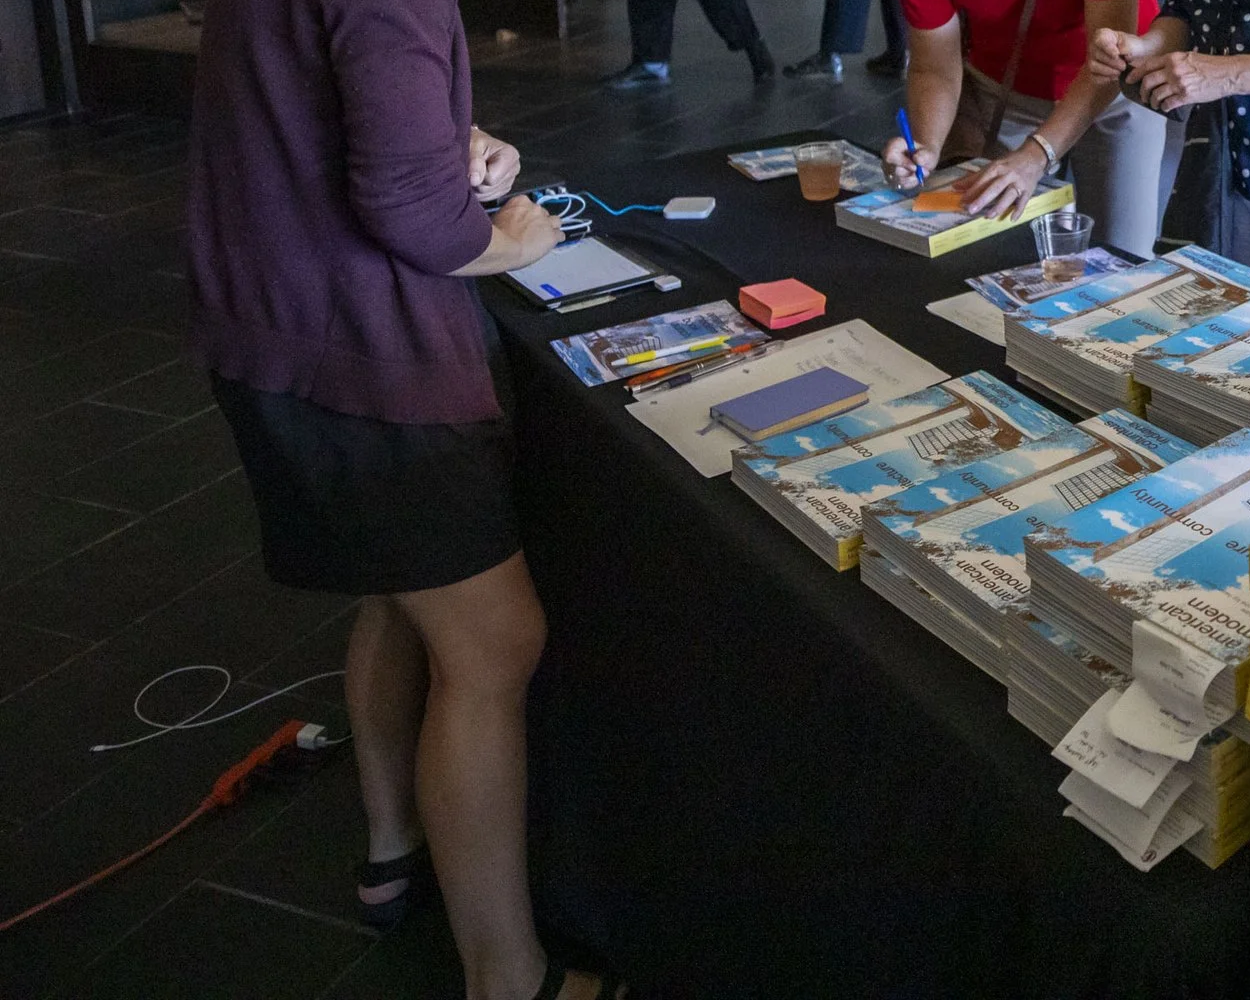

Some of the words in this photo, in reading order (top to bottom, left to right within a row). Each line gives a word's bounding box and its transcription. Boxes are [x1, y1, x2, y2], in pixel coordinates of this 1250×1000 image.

[958, 472, 1020, 513] community
[1130, 488, 1214, 538] community
[806, 497, 852, 535] american
[956, 560, 1016, 604] american
[979, 560, 1031, 597] modern
[1158, 602, 1243, 651] american
